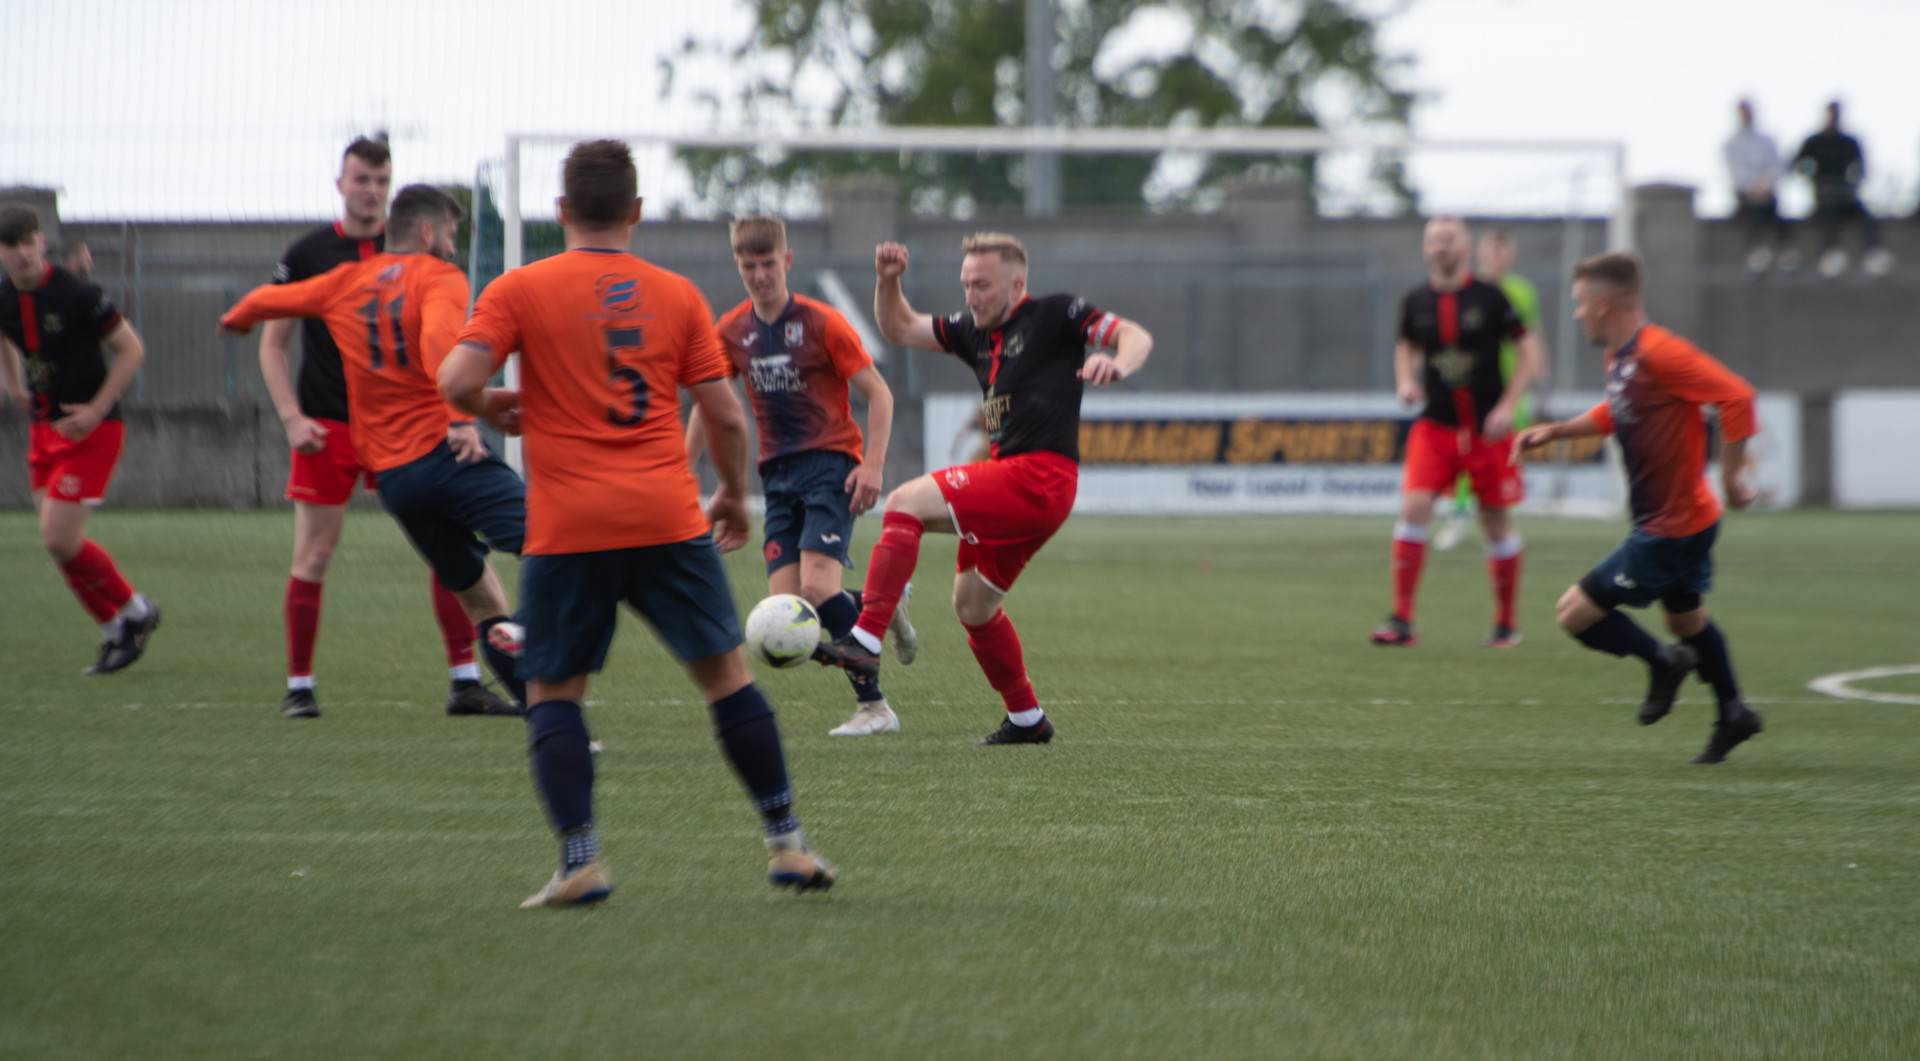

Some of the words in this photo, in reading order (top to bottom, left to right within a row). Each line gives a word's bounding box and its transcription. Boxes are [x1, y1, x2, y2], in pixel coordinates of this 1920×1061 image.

[357, 293, 409, 370] 11
[604, 326, 649, 428] 5
[1224, 415, 1398, 466] SPORTS
